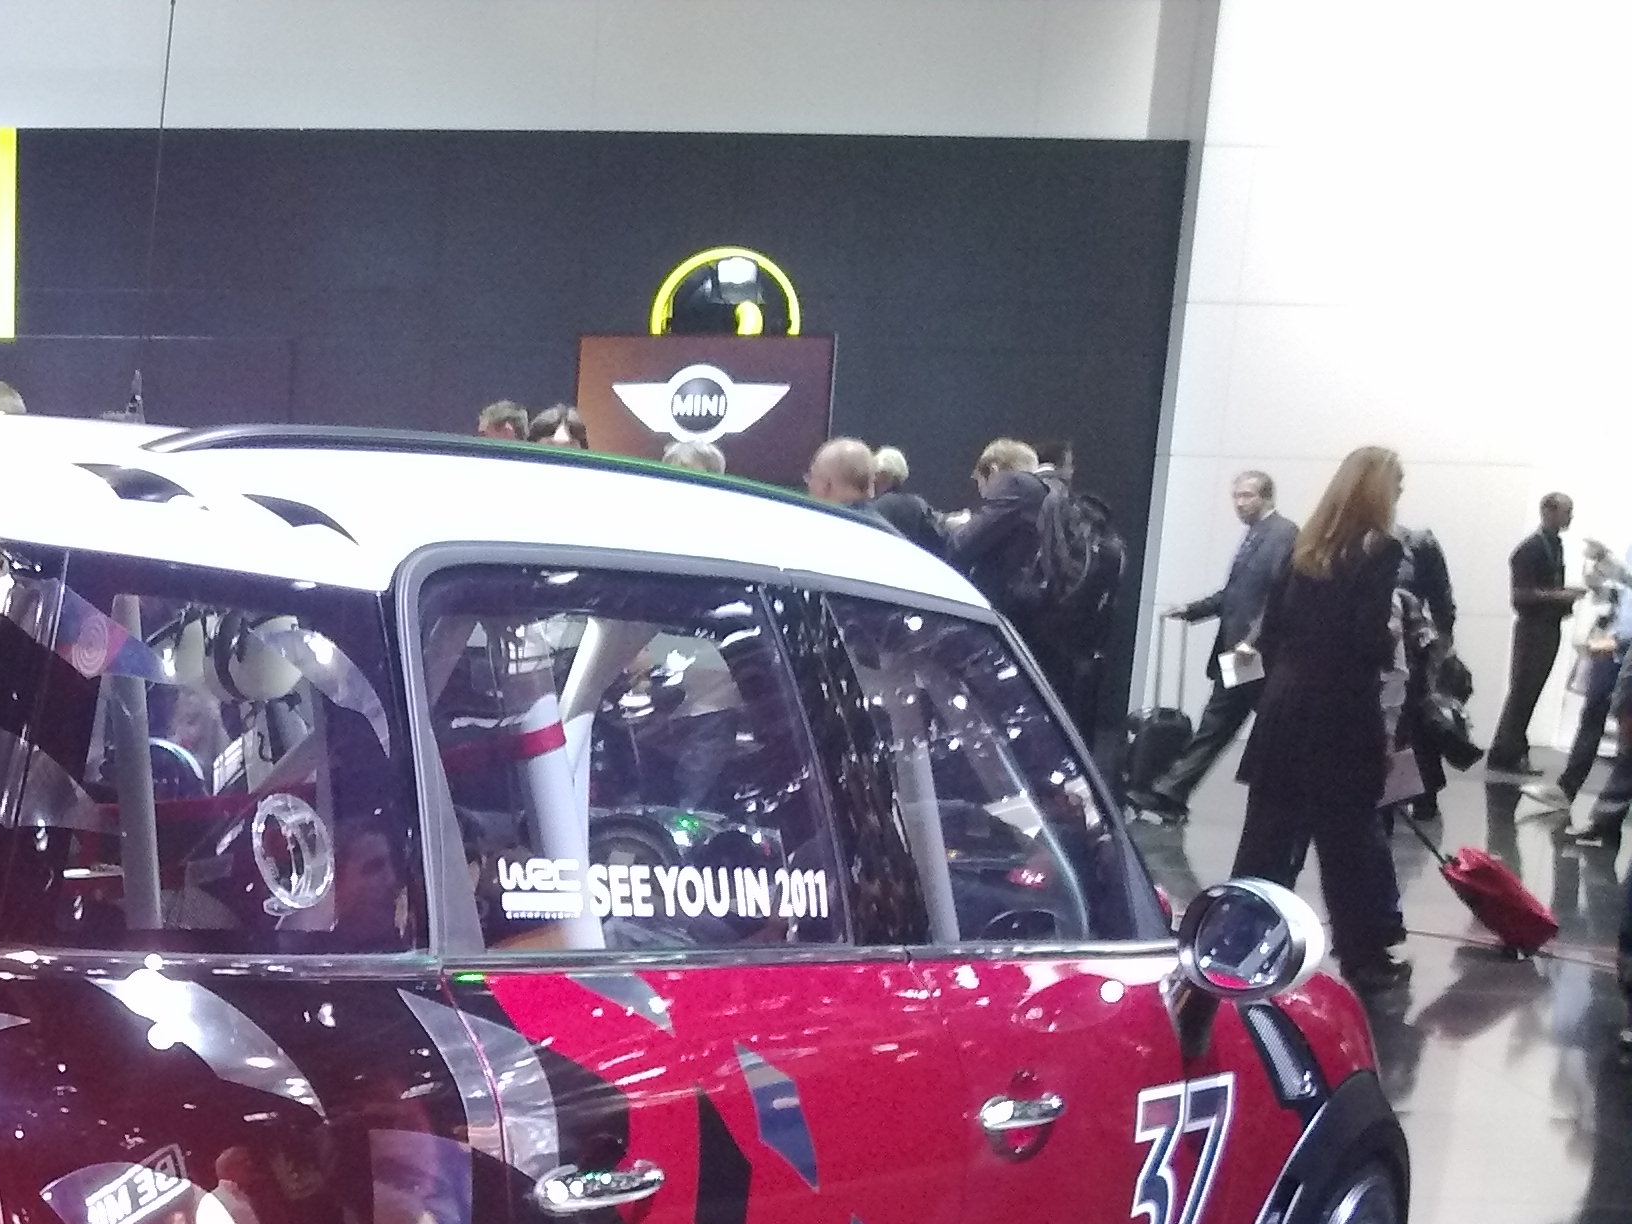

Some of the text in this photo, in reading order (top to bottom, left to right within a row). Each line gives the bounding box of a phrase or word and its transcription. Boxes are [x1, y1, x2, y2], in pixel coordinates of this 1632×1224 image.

[671, 393, 726, 417] MINI
[497, 857, 829, 919] WRC SEE YOU IN 2011
